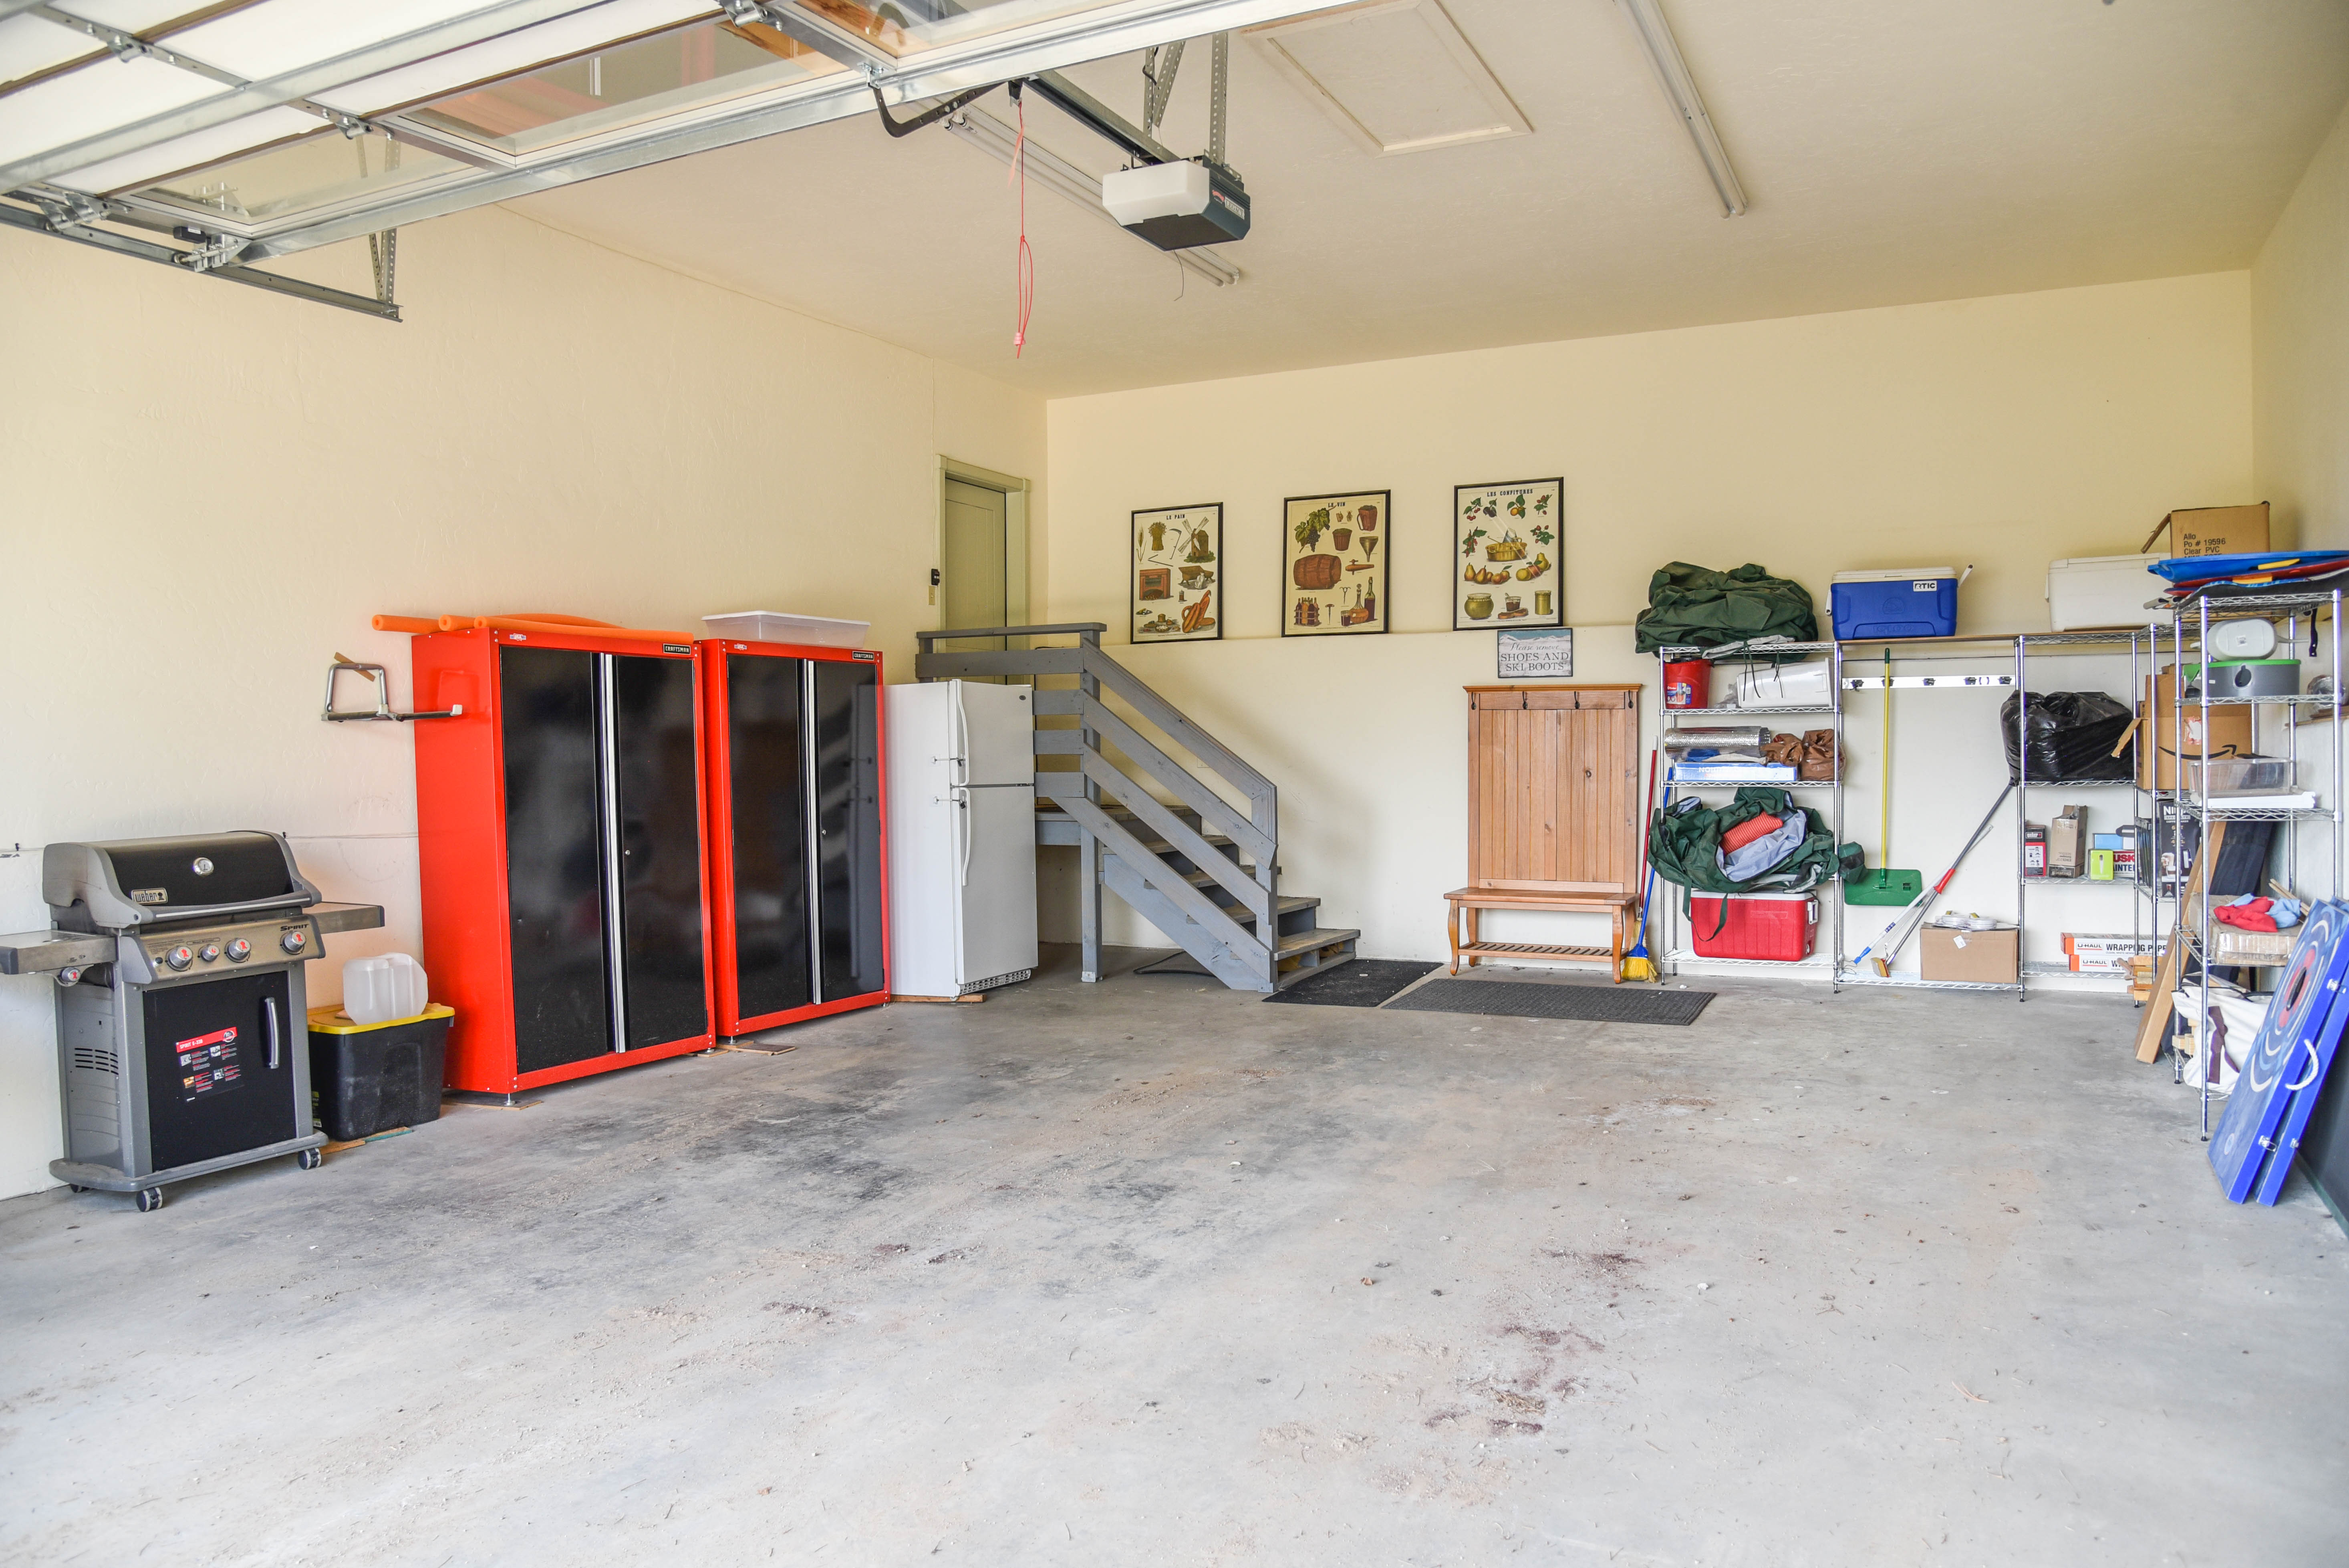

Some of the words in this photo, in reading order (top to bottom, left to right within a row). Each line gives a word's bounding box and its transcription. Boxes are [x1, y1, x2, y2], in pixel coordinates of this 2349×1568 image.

[1510, 642, 1533, 651] Please
[1501, 653, 1539, 662] SHOES
[1543, 652, 1569, 660] AND
[1506, 663, 1524, 671] SKI
[1529, 662, 1564, 671] BOOTS
[2113, 854, 2135, 862] USK
[135, 891, 157, 902] weber
